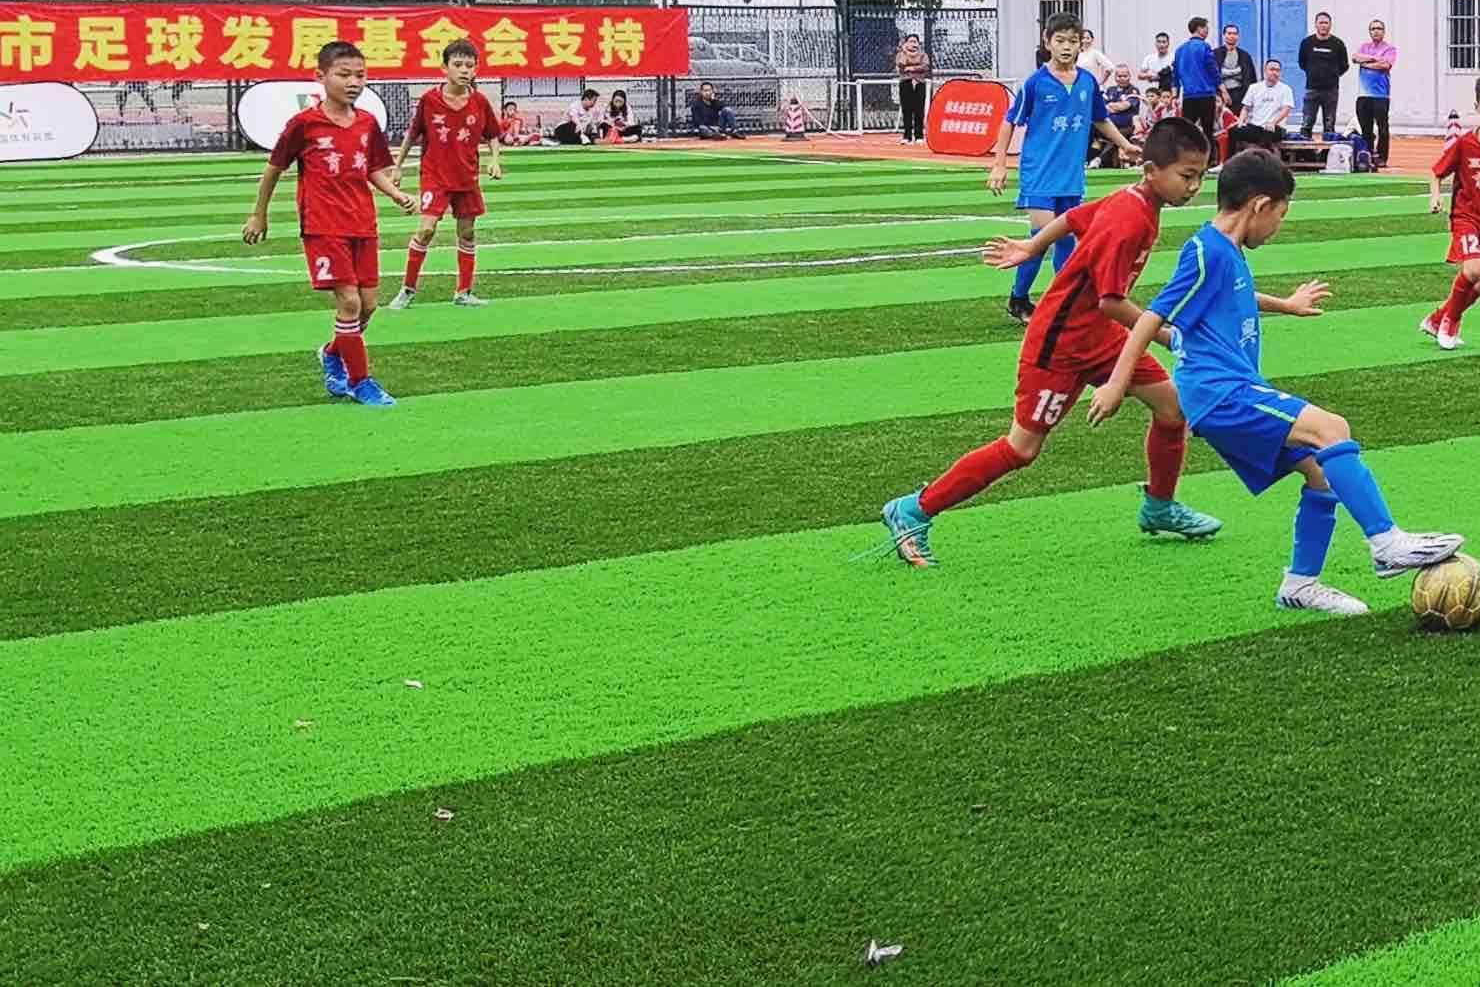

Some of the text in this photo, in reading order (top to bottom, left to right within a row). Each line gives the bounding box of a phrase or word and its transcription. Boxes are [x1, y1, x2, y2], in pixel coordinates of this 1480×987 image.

[0, 14, 645, 72] 市足球发展基金会支持
[421, 191, 433, 210] 9
[315, 256, 333, 281] 2
[1031, 388, 1069, 425] 15
